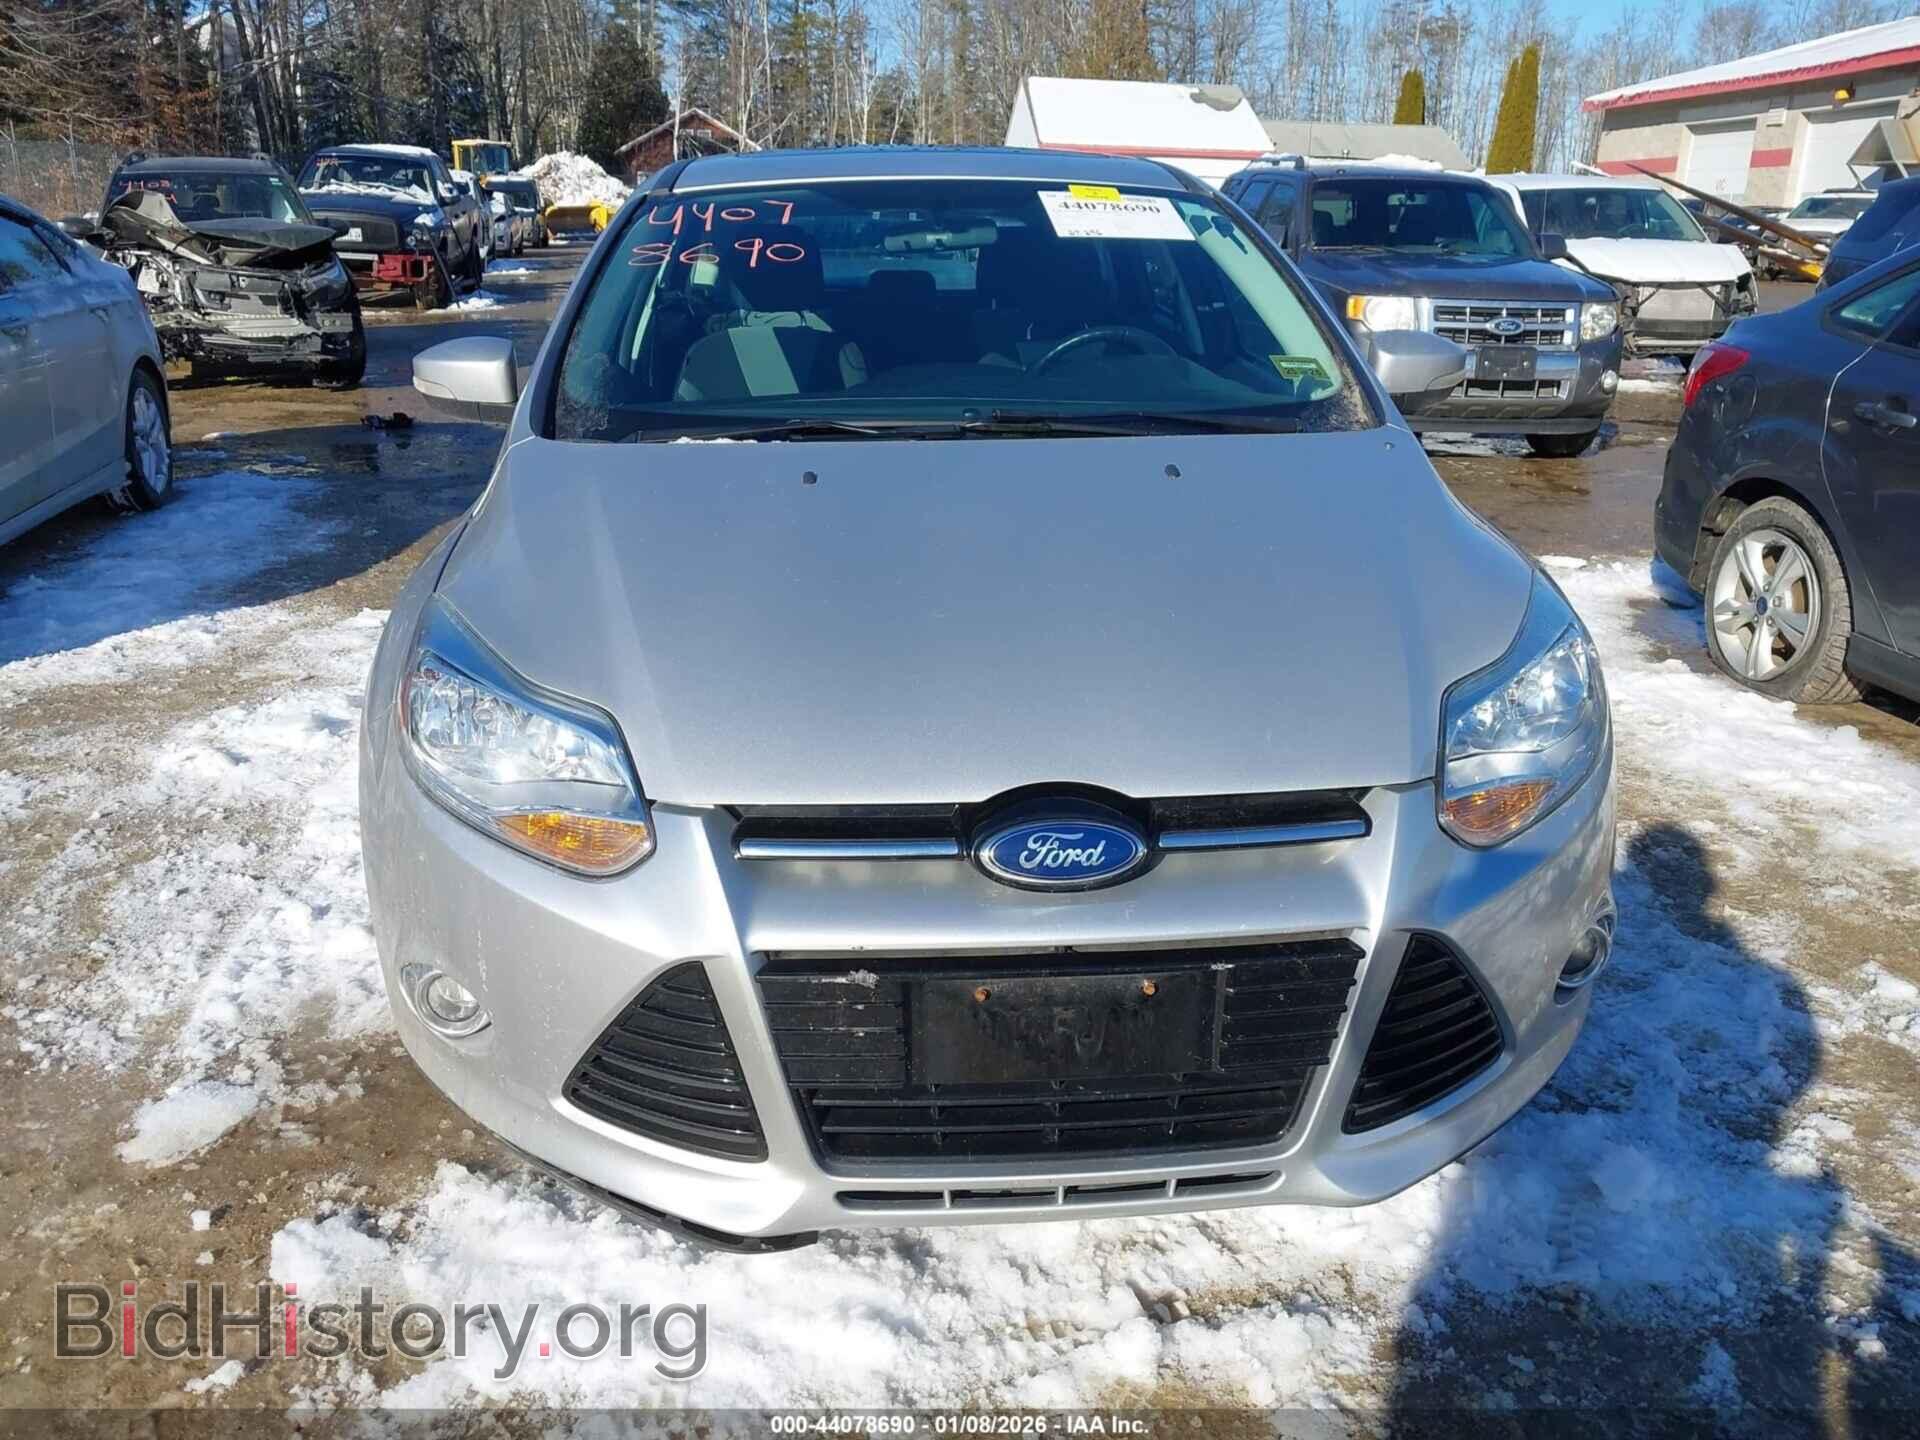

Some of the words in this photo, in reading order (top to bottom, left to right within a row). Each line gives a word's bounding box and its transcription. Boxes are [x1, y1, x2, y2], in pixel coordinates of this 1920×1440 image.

[648, 200, 794, 235] 4407
[1058, 201, 1161, 214] 44078690
[628, 238, 805, 268] 8690
[1018, 832, 1107, 869] Ford
